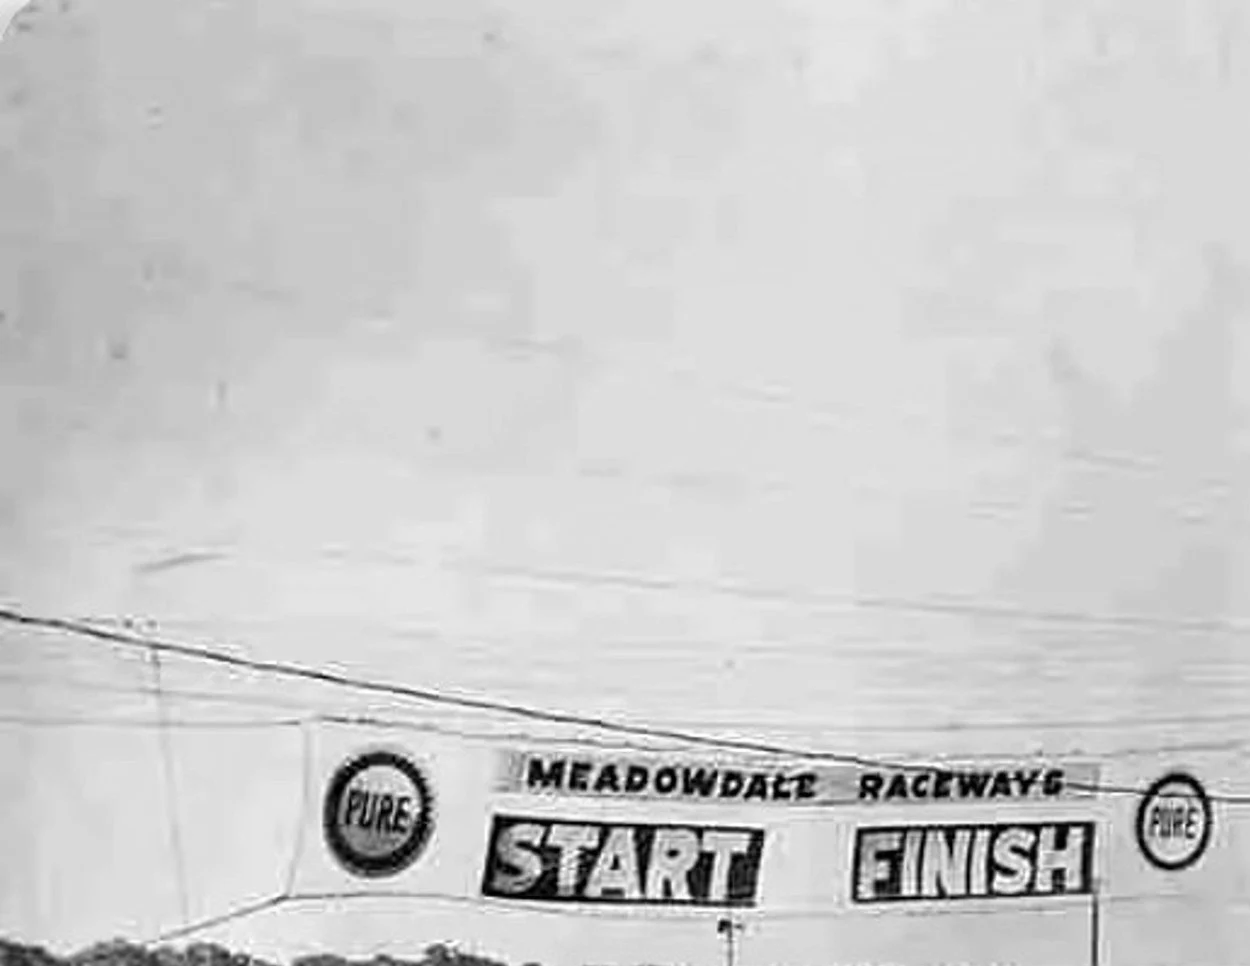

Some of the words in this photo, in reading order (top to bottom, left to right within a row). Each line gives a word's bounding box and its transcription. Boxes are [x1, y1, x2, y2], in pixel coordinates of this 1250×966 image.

[527, 758, 816, 801] MEADOWDALE
[858, 767, 1065, 799] RACEWAYS
[345, 789, 411, 833] PURE
[1149, 805, 1199, 839] PURE
[494, 823, 755, 901] START
[857, 826, 1086, 900] FINISH
